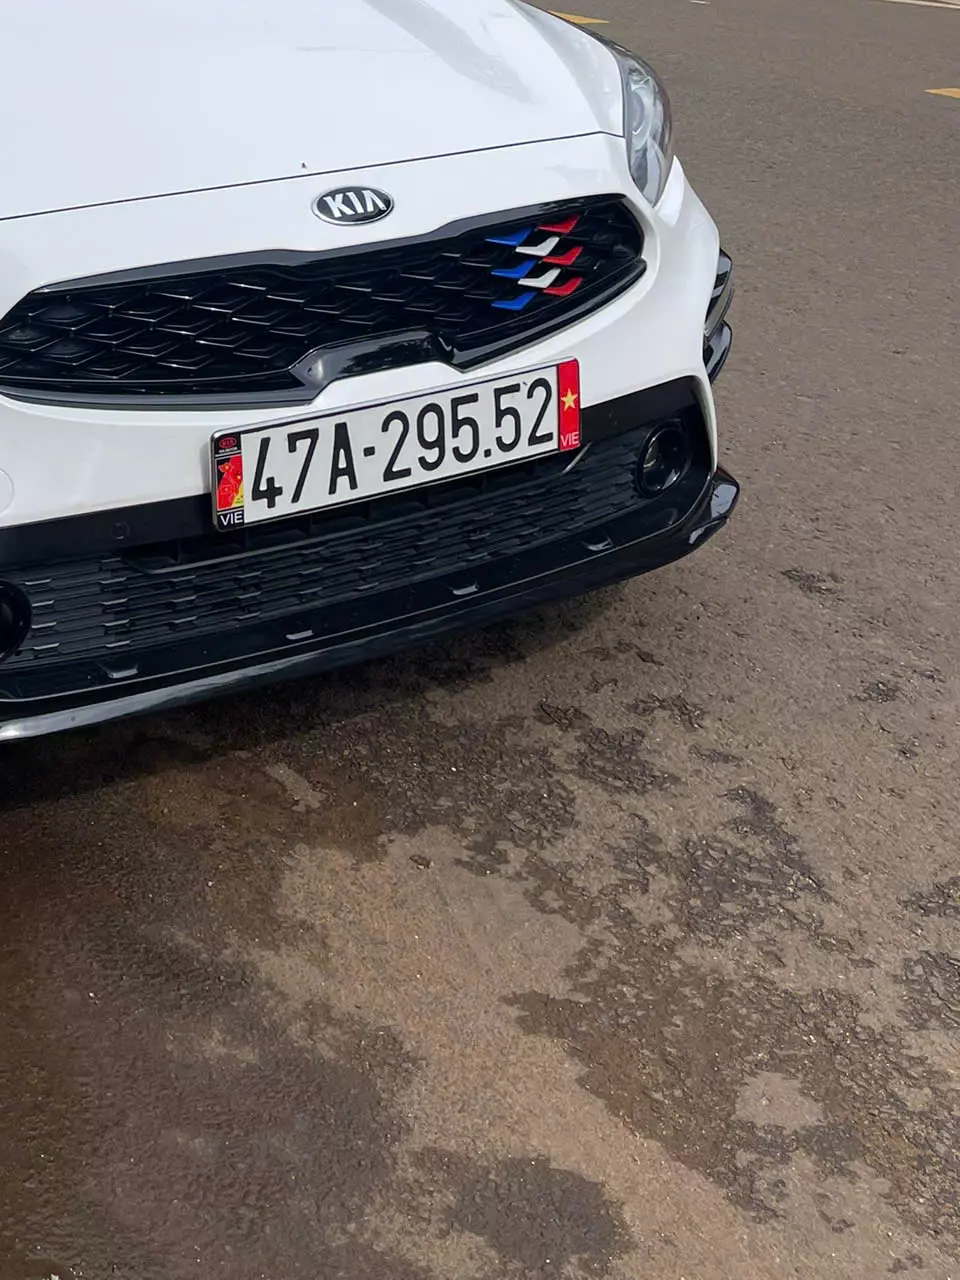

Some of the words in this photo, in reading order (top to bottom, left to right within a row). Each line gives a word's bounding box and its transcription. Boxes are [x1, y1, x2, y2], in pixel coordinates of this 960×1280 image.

[322, 189, 388, 218] KIA
[251, 376, 554, 509] 47A-295.52
[560, 431, 580, 447] VIE
[220, 510, 244, 526] VIE
